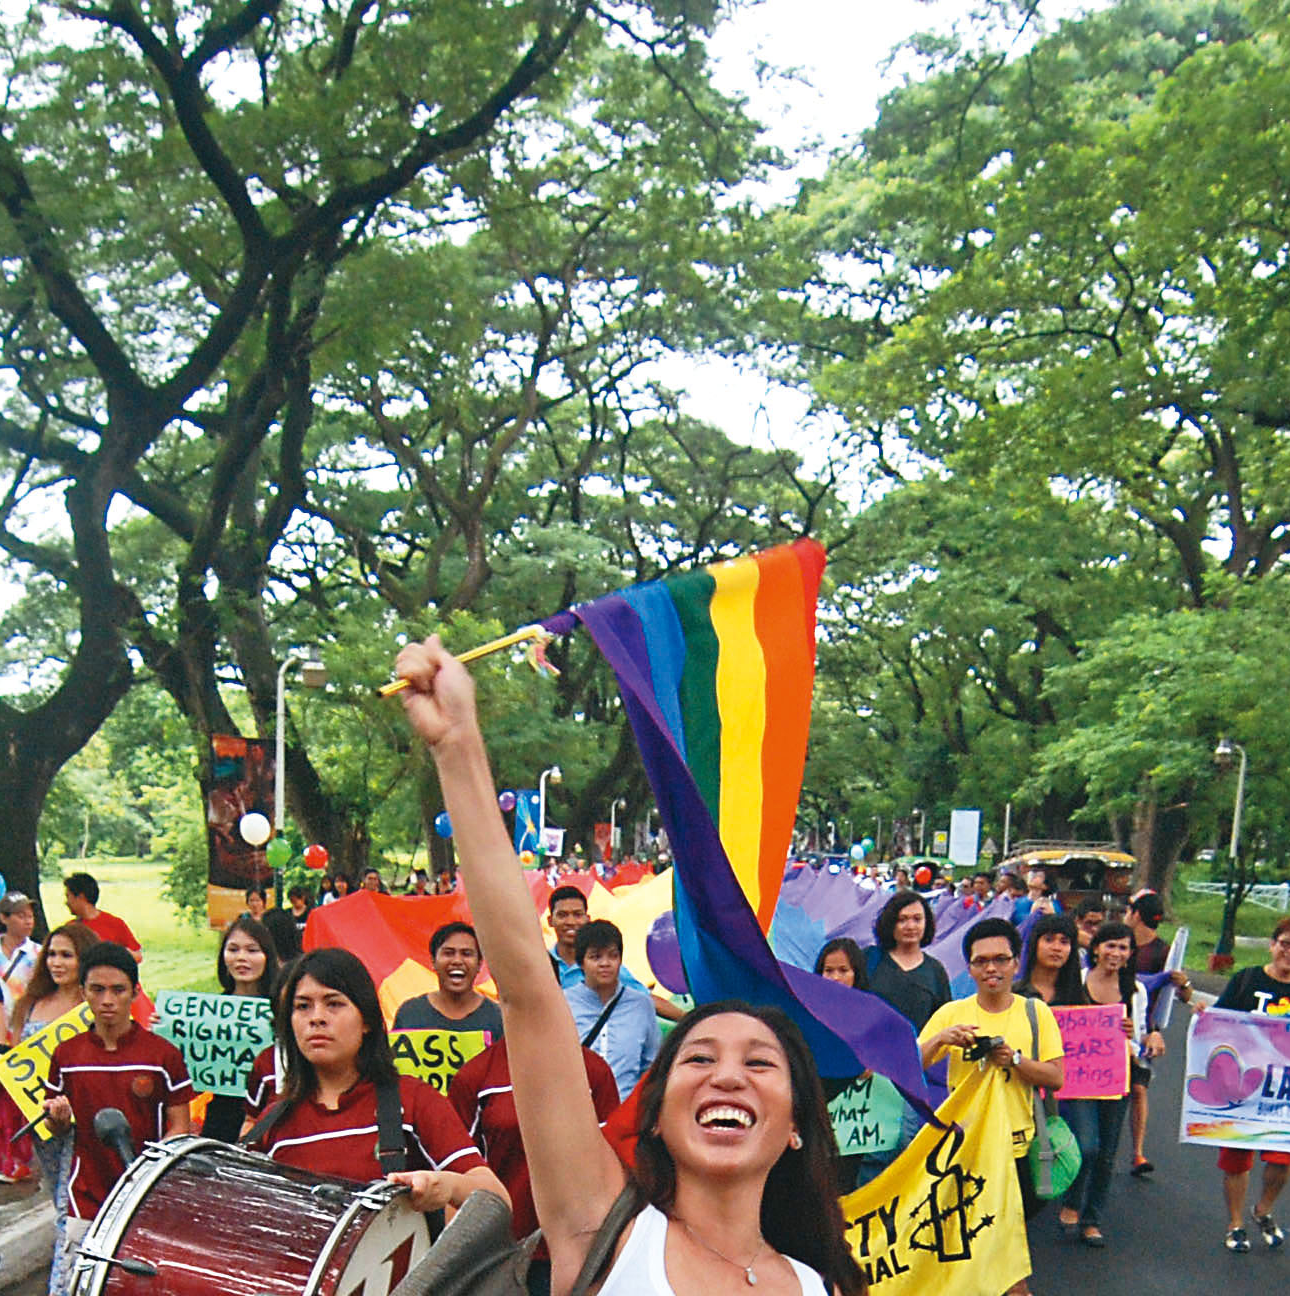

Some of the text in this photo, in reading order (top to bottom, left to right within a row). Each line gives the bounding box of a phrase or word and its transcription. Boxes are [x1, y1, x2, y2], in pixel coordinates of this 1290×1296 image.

[165, 997, 274, 1021] GENDER
[173, 1019, 262, 1045] RIGHTS
[180, 1042, 255, 1067] UMA
[1063, 1039, 1115, 1058] EARS
[193, 1066, 251, 1087] IGHT
[846, 1121, 886, 1148] AM.
